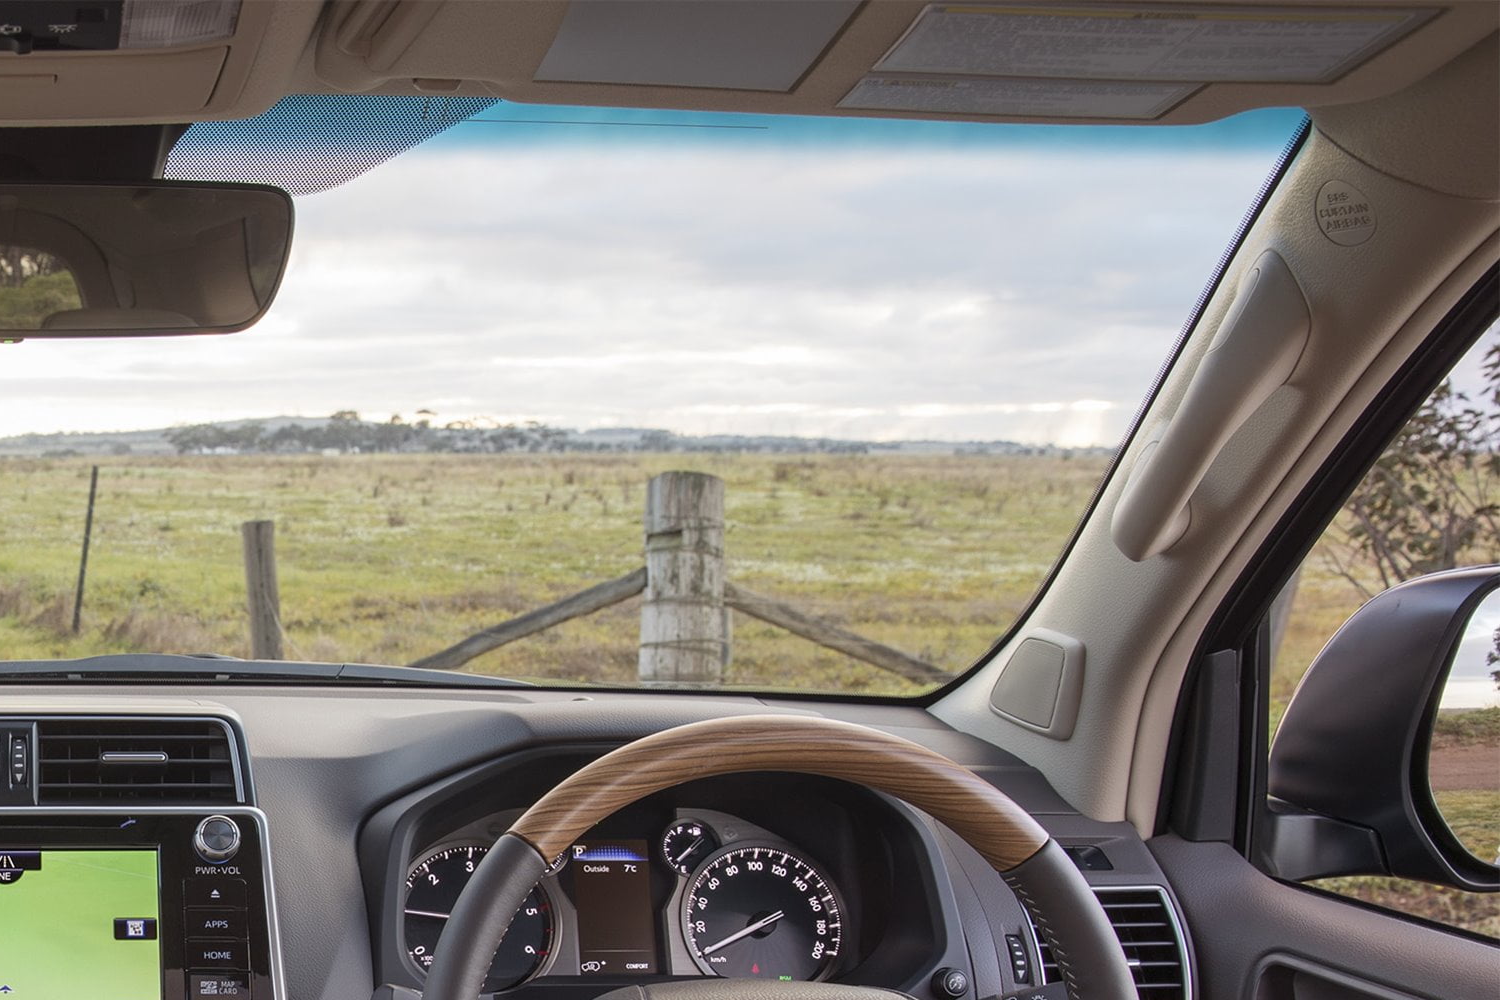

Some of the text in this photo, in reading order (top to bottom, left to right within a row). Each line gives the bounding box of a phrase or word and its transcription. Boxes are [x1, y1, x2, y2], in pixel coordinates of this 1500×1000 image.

[1319, 203, 1369, 218] CURTAIN
[1325, 216, 1372, 230] AIRBAG
[677, 826, 683, 834] F
[465, 862, 473, 872] 3
[584, 864, 609, 873] Outside
[726, 865, 738, 876] 80
[748, 862, 763, 871] 100
[771, 865, 787, 877] 120
[428, 874, 439, 885] 2
[708, 878, 720, 890] 60
[792, 877, 807, 892] 140
[697, 898, 708, 910] 40
[808, 896, 821, 912] 160
[526, 908, 537, 916] 5
[204, 920, 228, 929] APPS
[696, 921, 706, 933] 20
[816, 919, 826, 935] 180
[203, 951, 231, 960] HOME
[414, 946, 425, 955] 0
[524, 946, 536, 954] 6
[811, 941, 825, 959] 200
